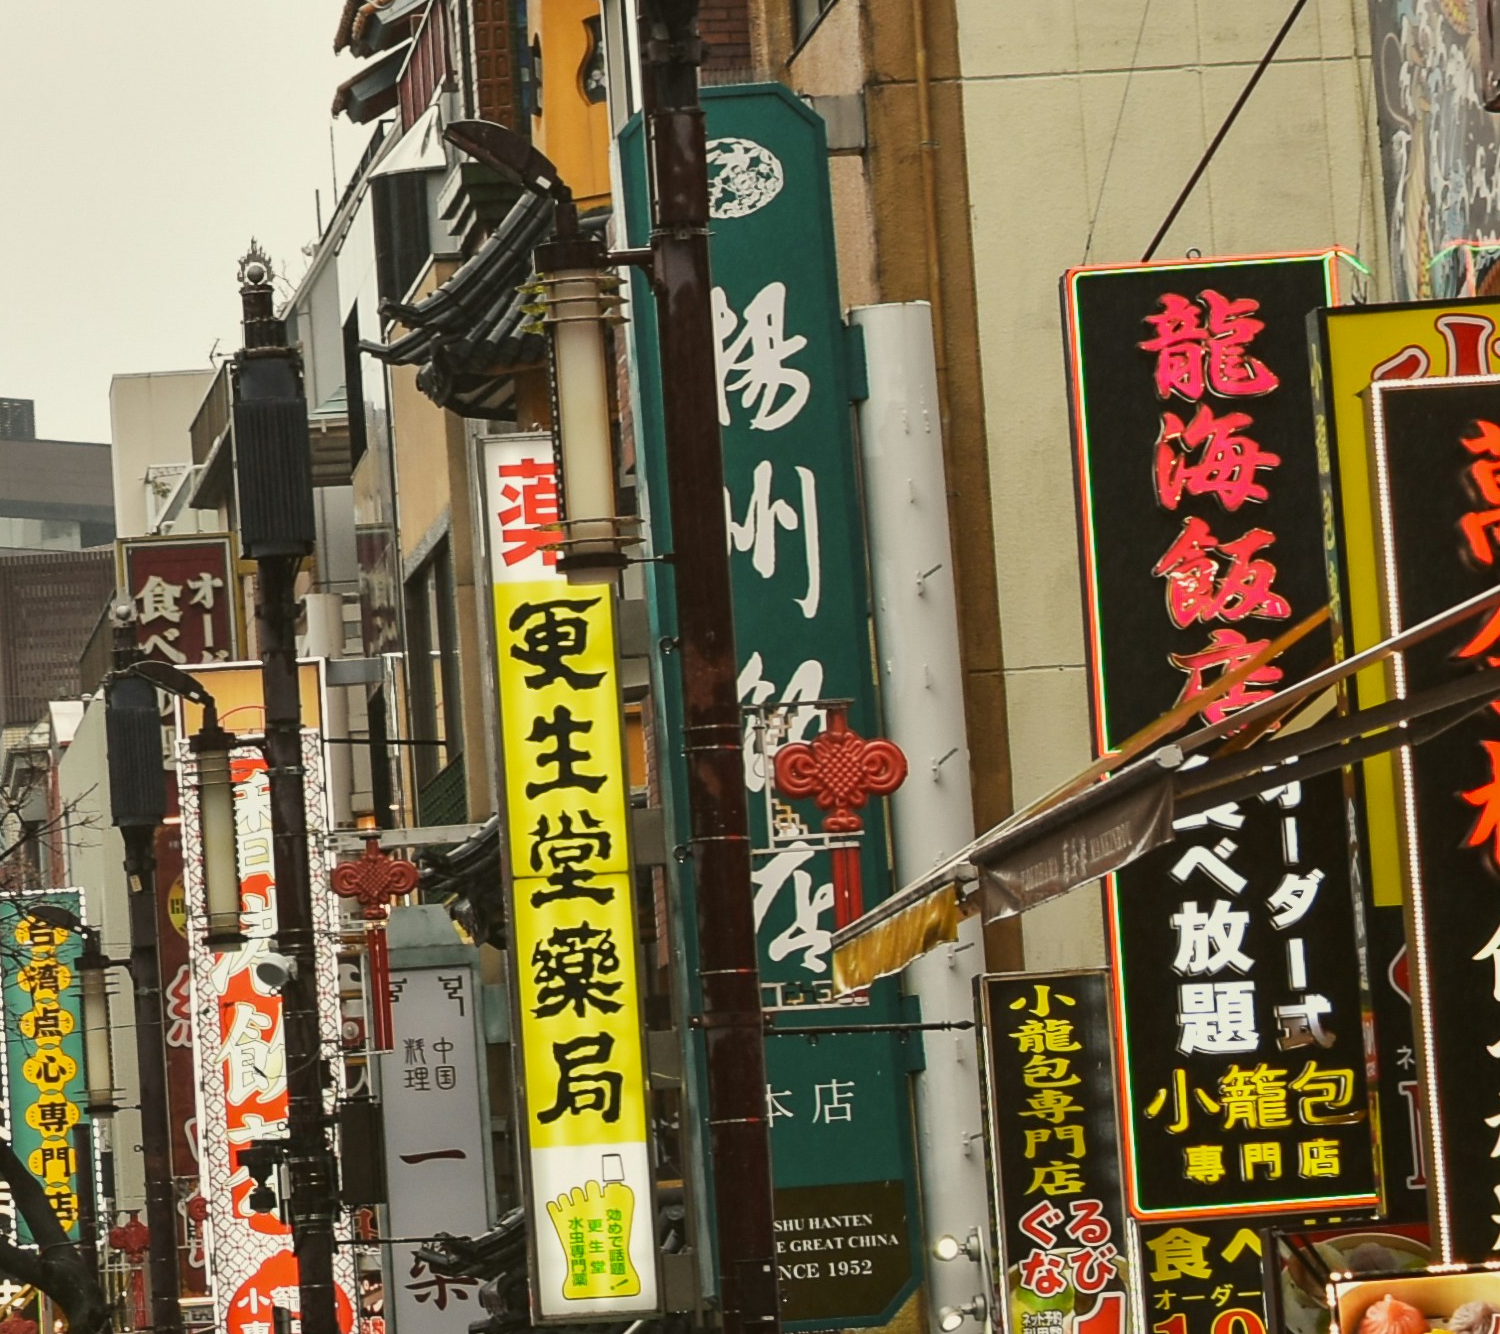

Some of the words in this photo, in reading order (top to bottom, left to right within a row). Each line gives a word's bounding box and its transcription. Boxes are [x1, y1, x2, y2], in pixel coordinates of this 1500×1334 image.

[187, 571, 230, 663] オー
[1144, 1060, 1366, 1135] 小籠包
[1182, 1137, 1342, 1185] 専門店
[790, 1237, 845, 1252] GREAT
[848, 1234, 900, 1248] CHINA
[809, 1214, 873, 1230] HANTEN
[1019, 1199, 1112, 1249] ぐる
[828, 1259, 873, 1278] 1952
[1020, 1242, 1116, 1297] なび
